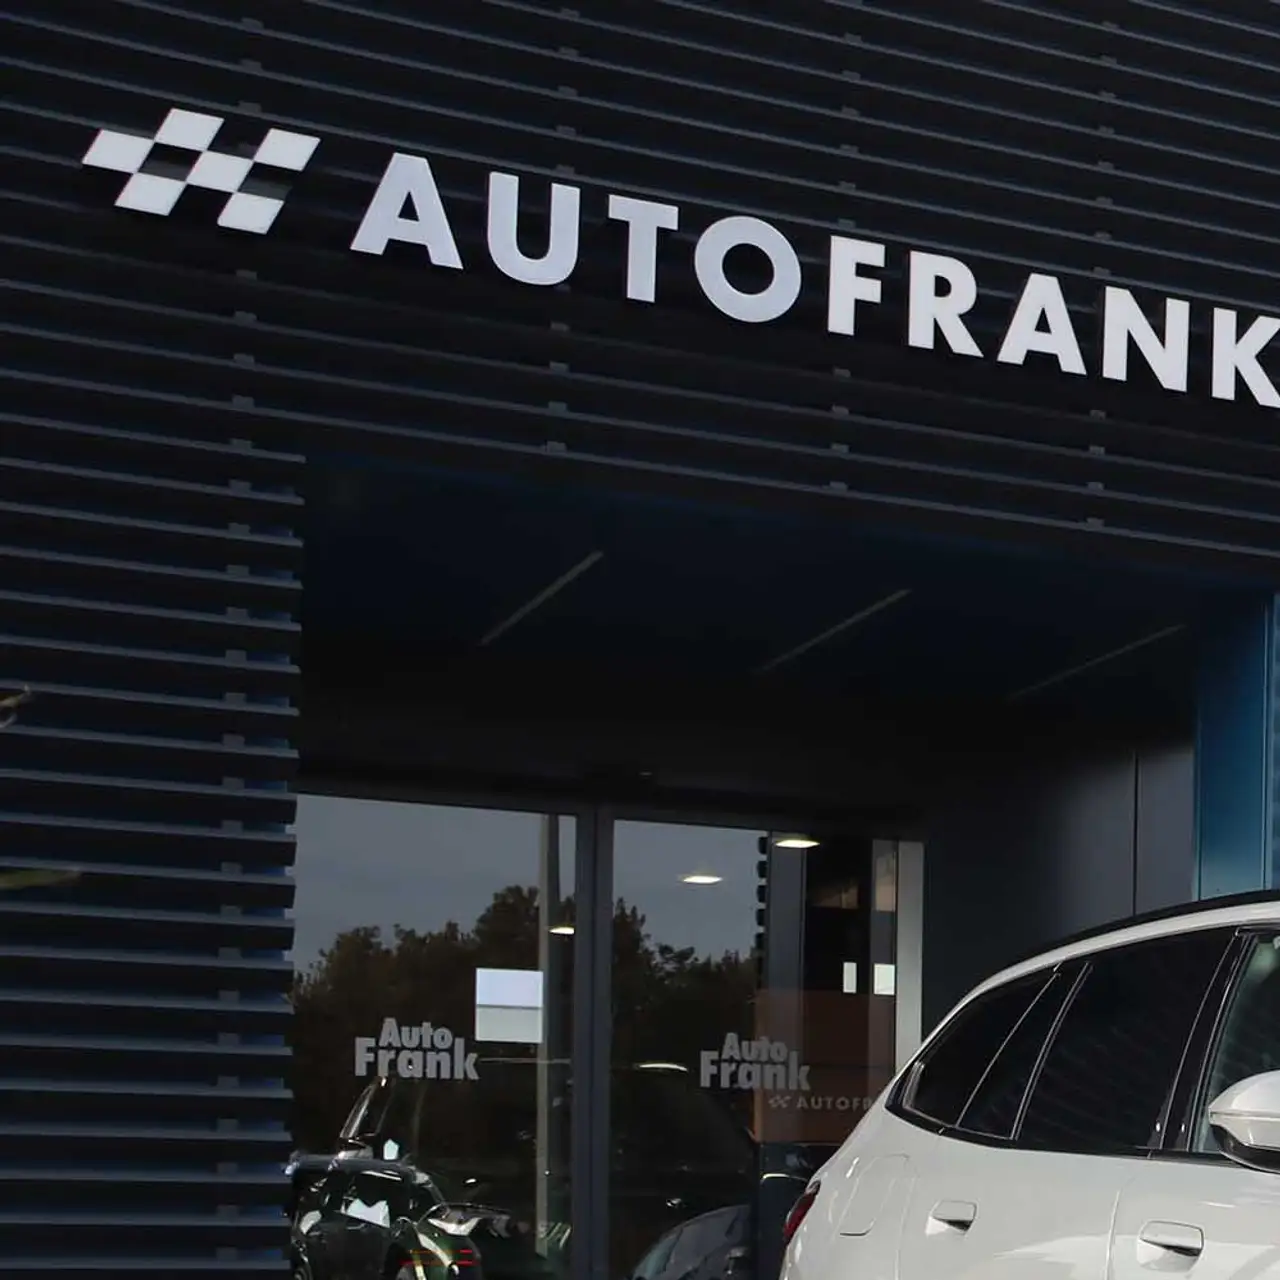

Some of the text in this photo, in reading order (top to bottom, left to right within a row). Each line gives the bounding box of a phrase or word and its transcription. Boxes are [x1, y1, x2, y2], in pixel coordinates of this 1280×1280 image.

[379, 1016, 453, 1049] Auto
[721, 1032, 788, 1062] Auto
[354, 1037, 479, 1080] Frank
[700, 1050, 811, 1091] Frank
